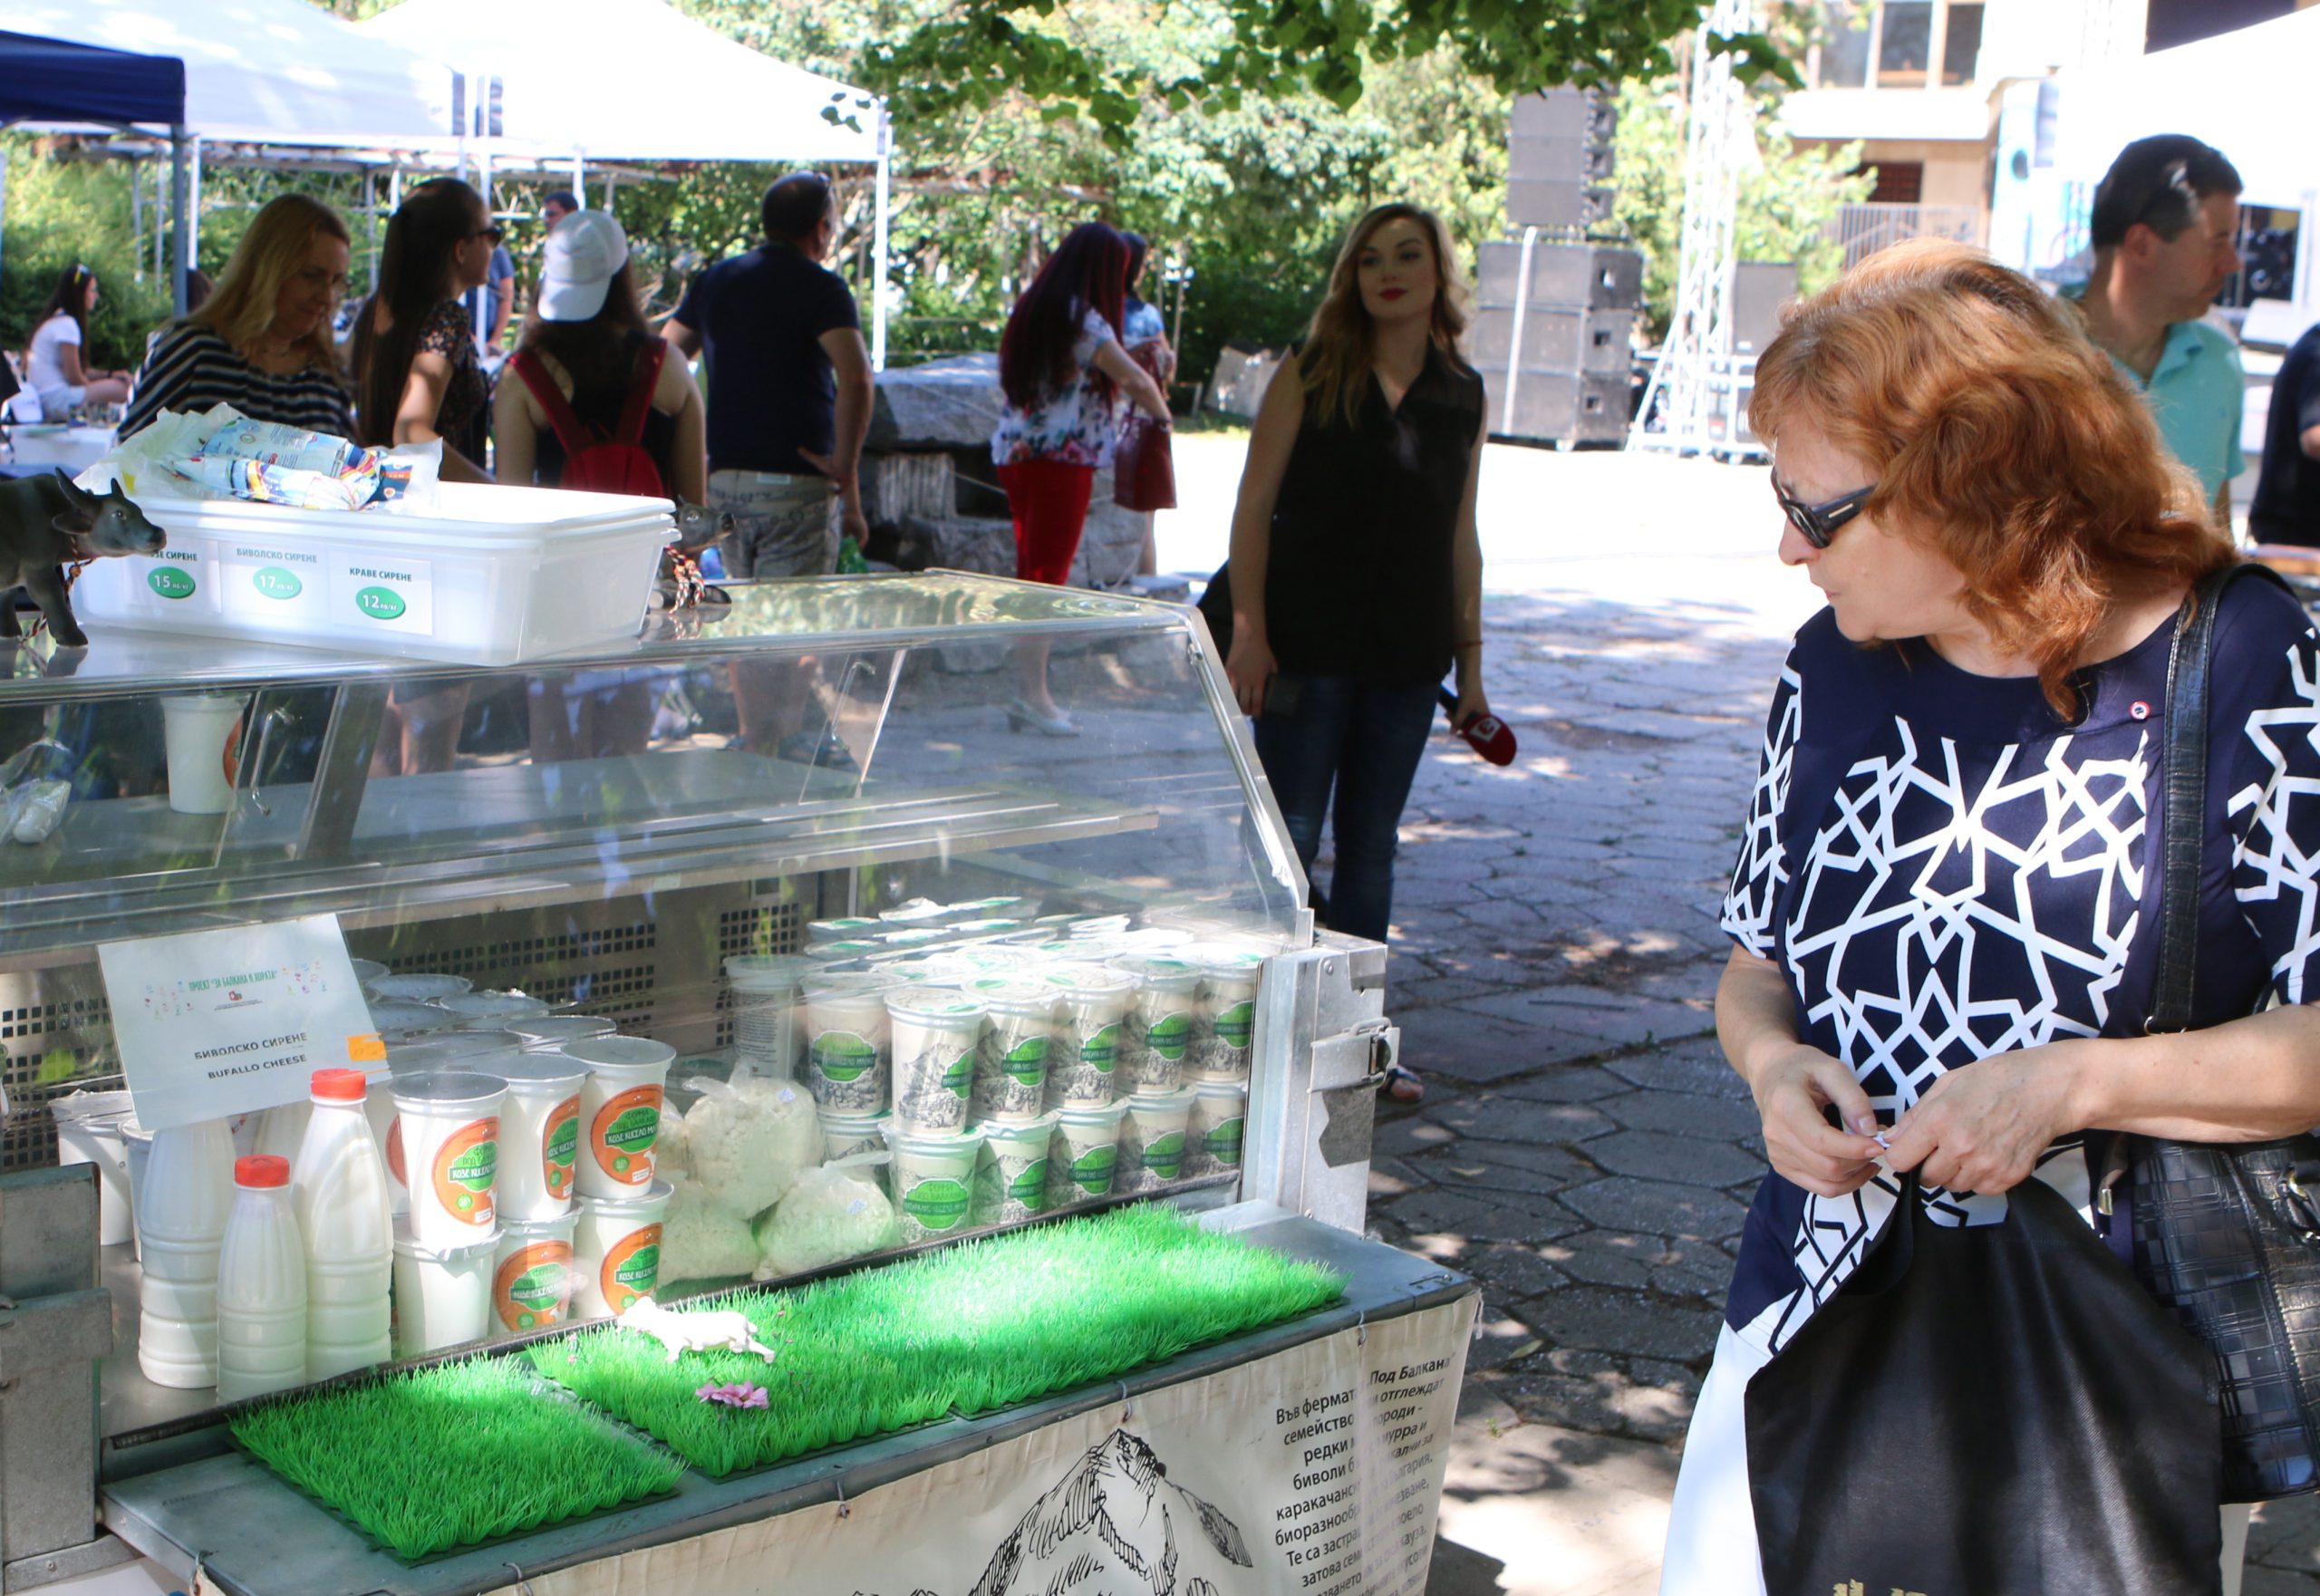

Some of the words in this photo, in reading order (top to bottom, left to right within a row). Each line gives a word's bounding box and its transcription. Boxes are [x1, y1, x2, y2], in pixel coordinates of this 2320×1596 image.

[166, 551, 198, 562] СИРЕНЕ
[236, 547, 283, 560] БИВОЛСКО
[285, 552, 317, 563] СИРЕНЕ
[154, 575, 170, 588] 15
[259, 575, 276, 588] 17
[350, 567, 377, 578] КРАВЕ
[379, 570, 412, 582] СИРЕНЕ
[362, 594, 380, 608] 12
[194, 1041, 259, 1059] БИВОЛСКО
[262, 1032, 307, 1049] СИРЕНЕ
[208, 1063, 260, 1079] BUFALLO
[263, 1054, 307, 1069] CHEESE
[1276, 1407, 1300, 1425] Във
[1302, 1388, 1357, 1417] фермат
[1283, 1413, 1355, 1446] семейство
[1380, 1378, 1445, 1402] отглеждат
[1304, 1439, 1348, 1466] редки
[1293, 1464, 1346, 1490] биволи
[1286, 1550, 1302, 1566] Те
[1306, 1546, 1320, 1561] са
[1301, 1561, 1341, 1587] затова
